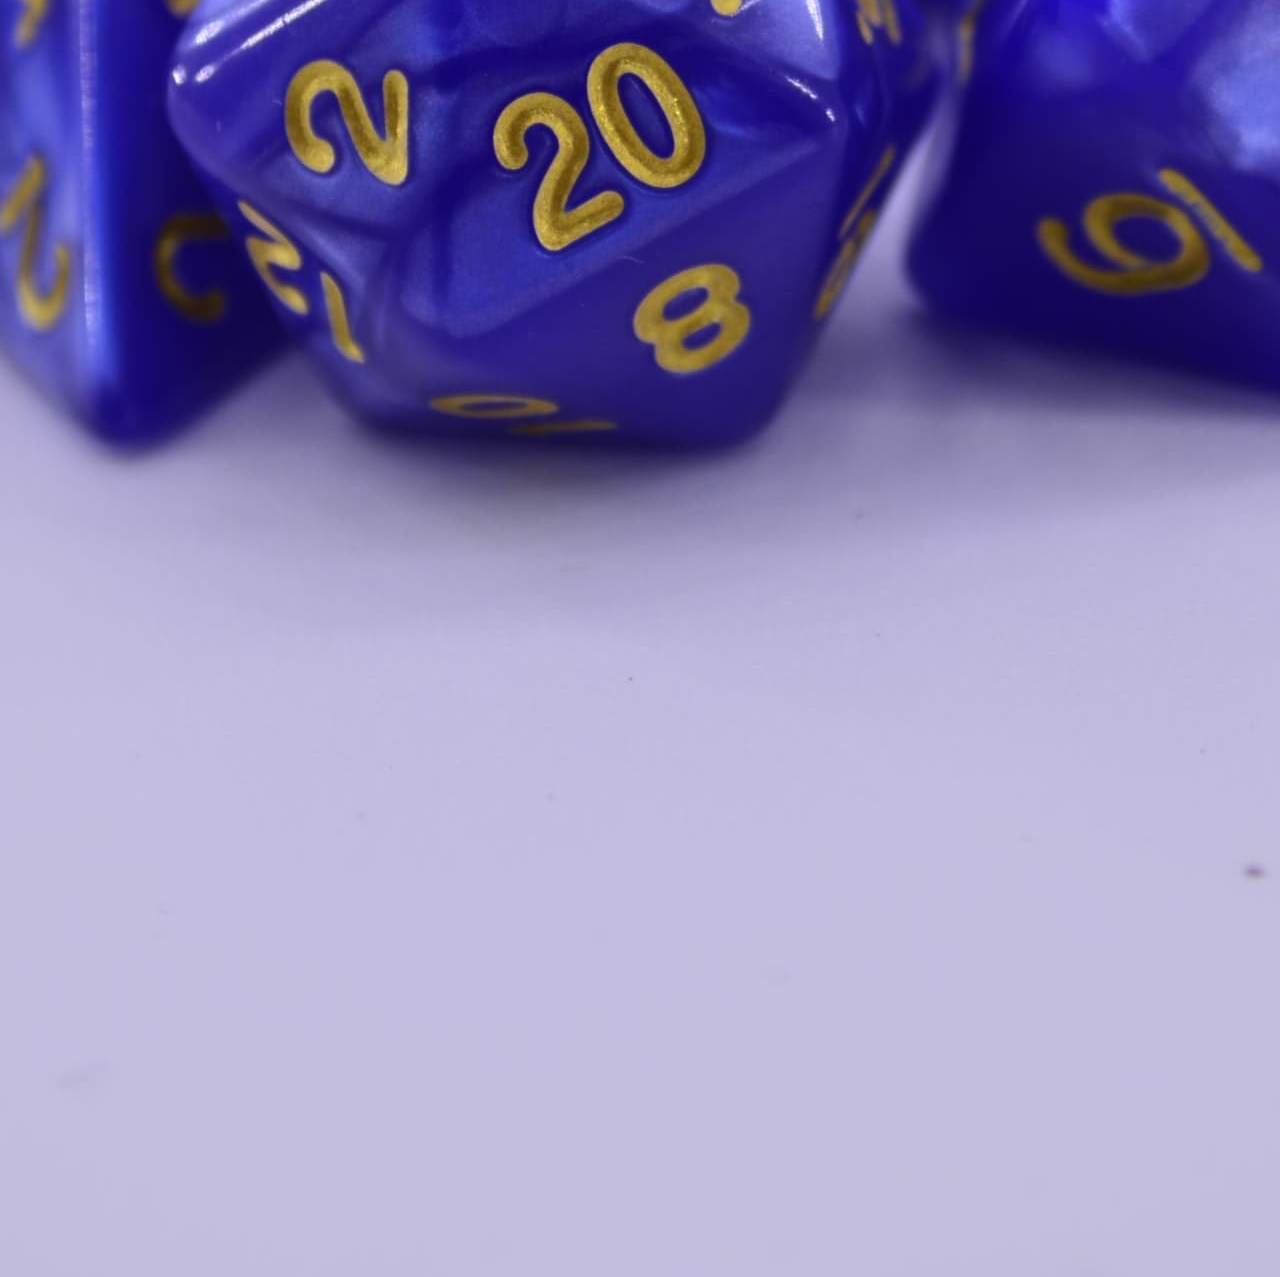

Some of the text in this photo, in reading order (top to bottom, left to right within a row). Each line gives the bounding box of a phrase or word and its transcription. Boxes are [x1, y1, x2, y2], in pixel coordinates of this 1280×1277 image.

[284, 59, 409, 186] 2
[492, 42, 707, 252] 20
[1036, 166, 1262, 295] 6
[633, 263, 751, 376] 8
